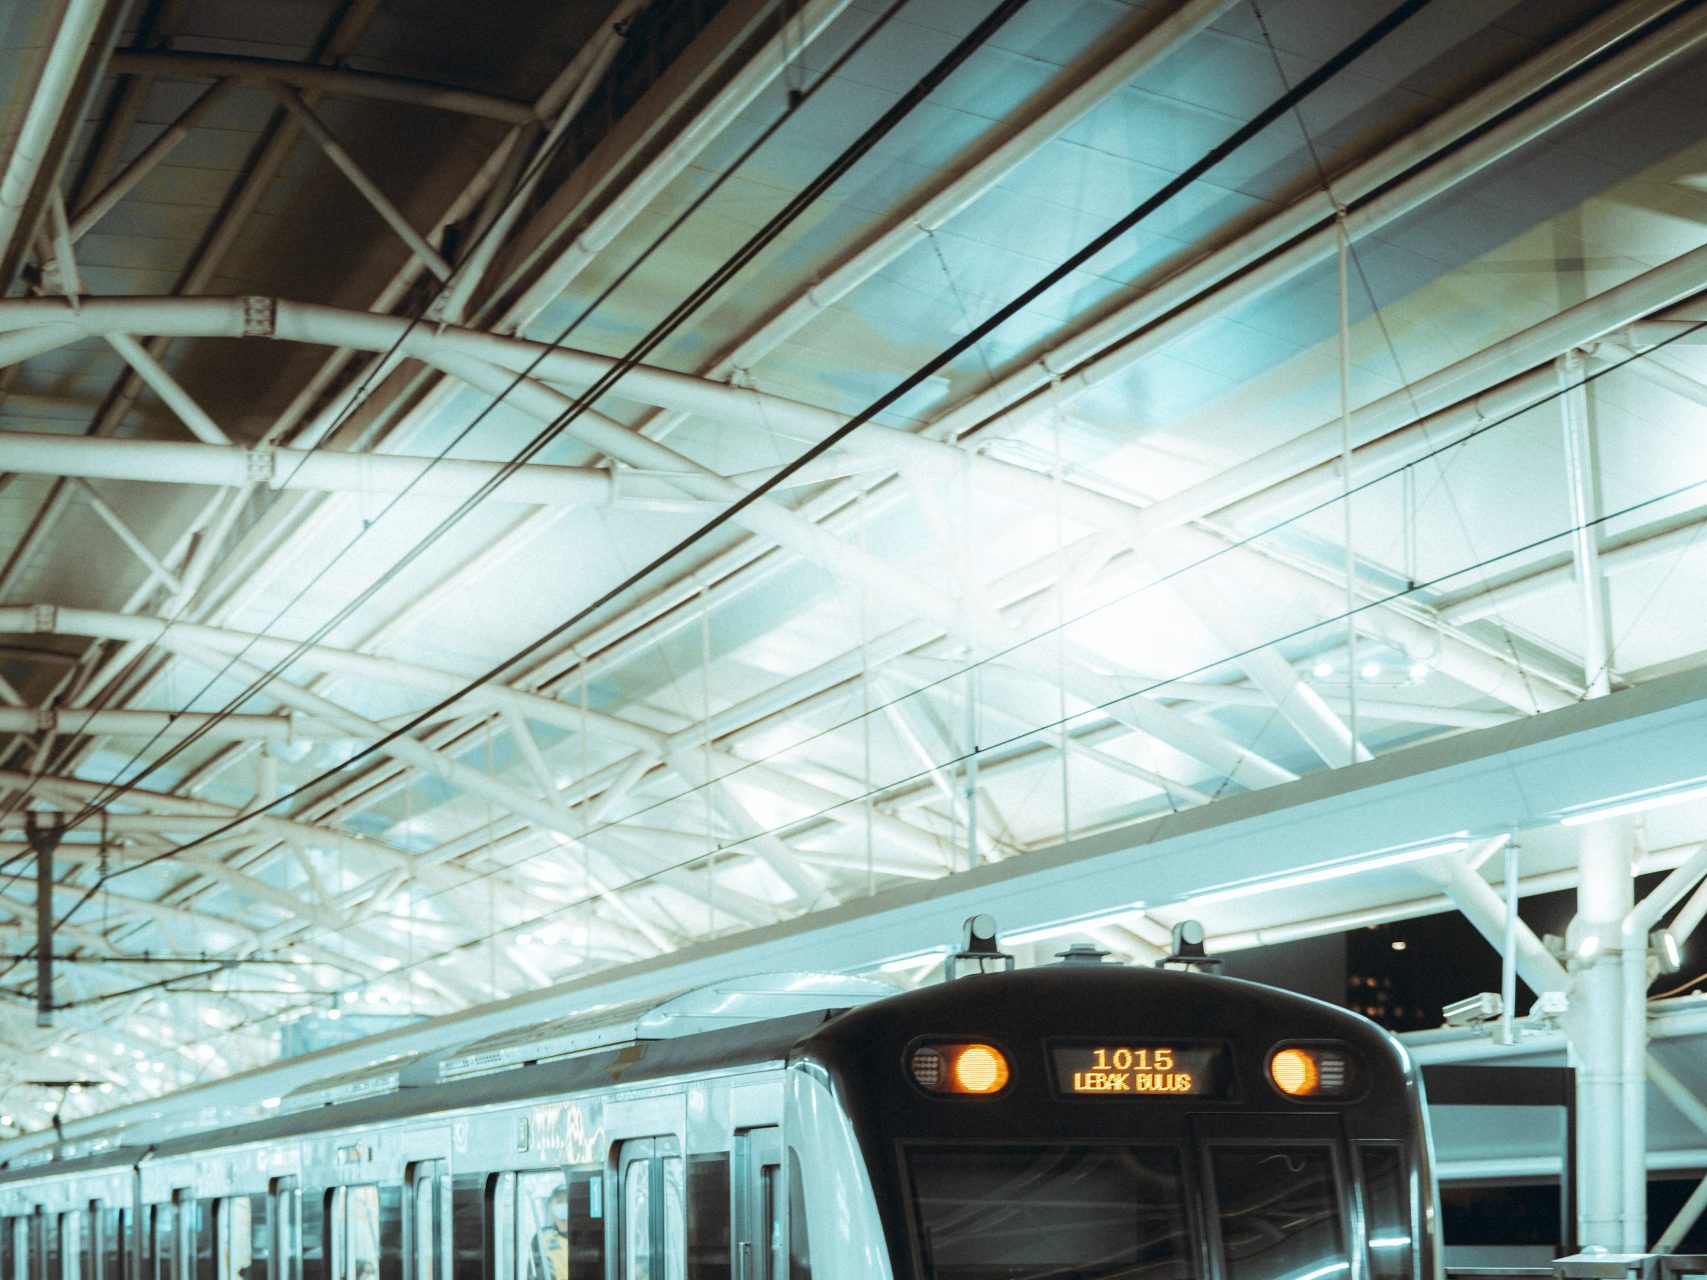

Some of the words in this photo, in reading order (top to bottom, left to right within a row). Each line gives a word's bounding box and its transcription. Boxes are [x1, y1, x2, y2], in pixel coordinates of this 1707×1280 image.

[1092, 1048, 1174, 1071] 1015
[1073, 1072, 1131, 1091] LEBAK
[1136, 1073, 1192, 1092] BULUS
